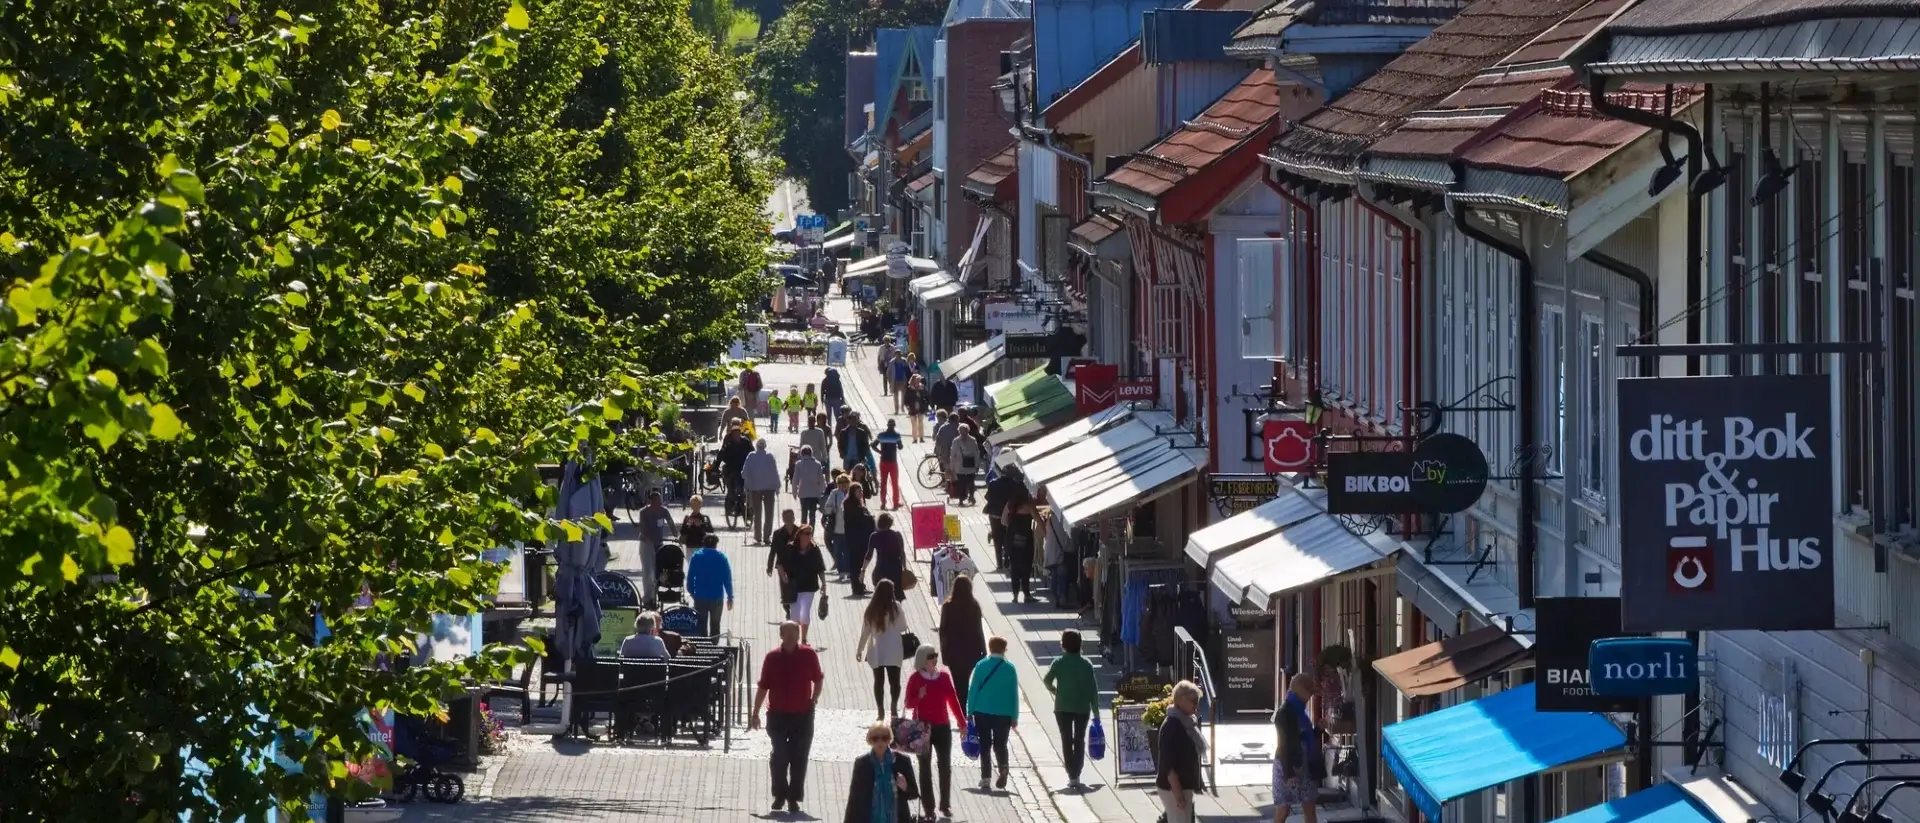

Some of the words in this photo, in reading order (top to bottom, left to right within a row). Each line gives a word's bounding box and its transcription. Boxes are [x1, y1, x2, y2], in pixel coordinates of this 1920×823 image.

[1630, 413, 1707, 461] ditt
[1724, 413, 1816, 460] Bok
[1345, 476, 1376, 492] BIK
[1427, 467, 1446, 484] by
[1699, 453, 1740, 496] &
[1665, 478, 1779, 539] Papir
[1730, 528, 1822, 573] Hus
[1604, 652, 1686, 679] norli
[369, 729, 392, 743] nte!
